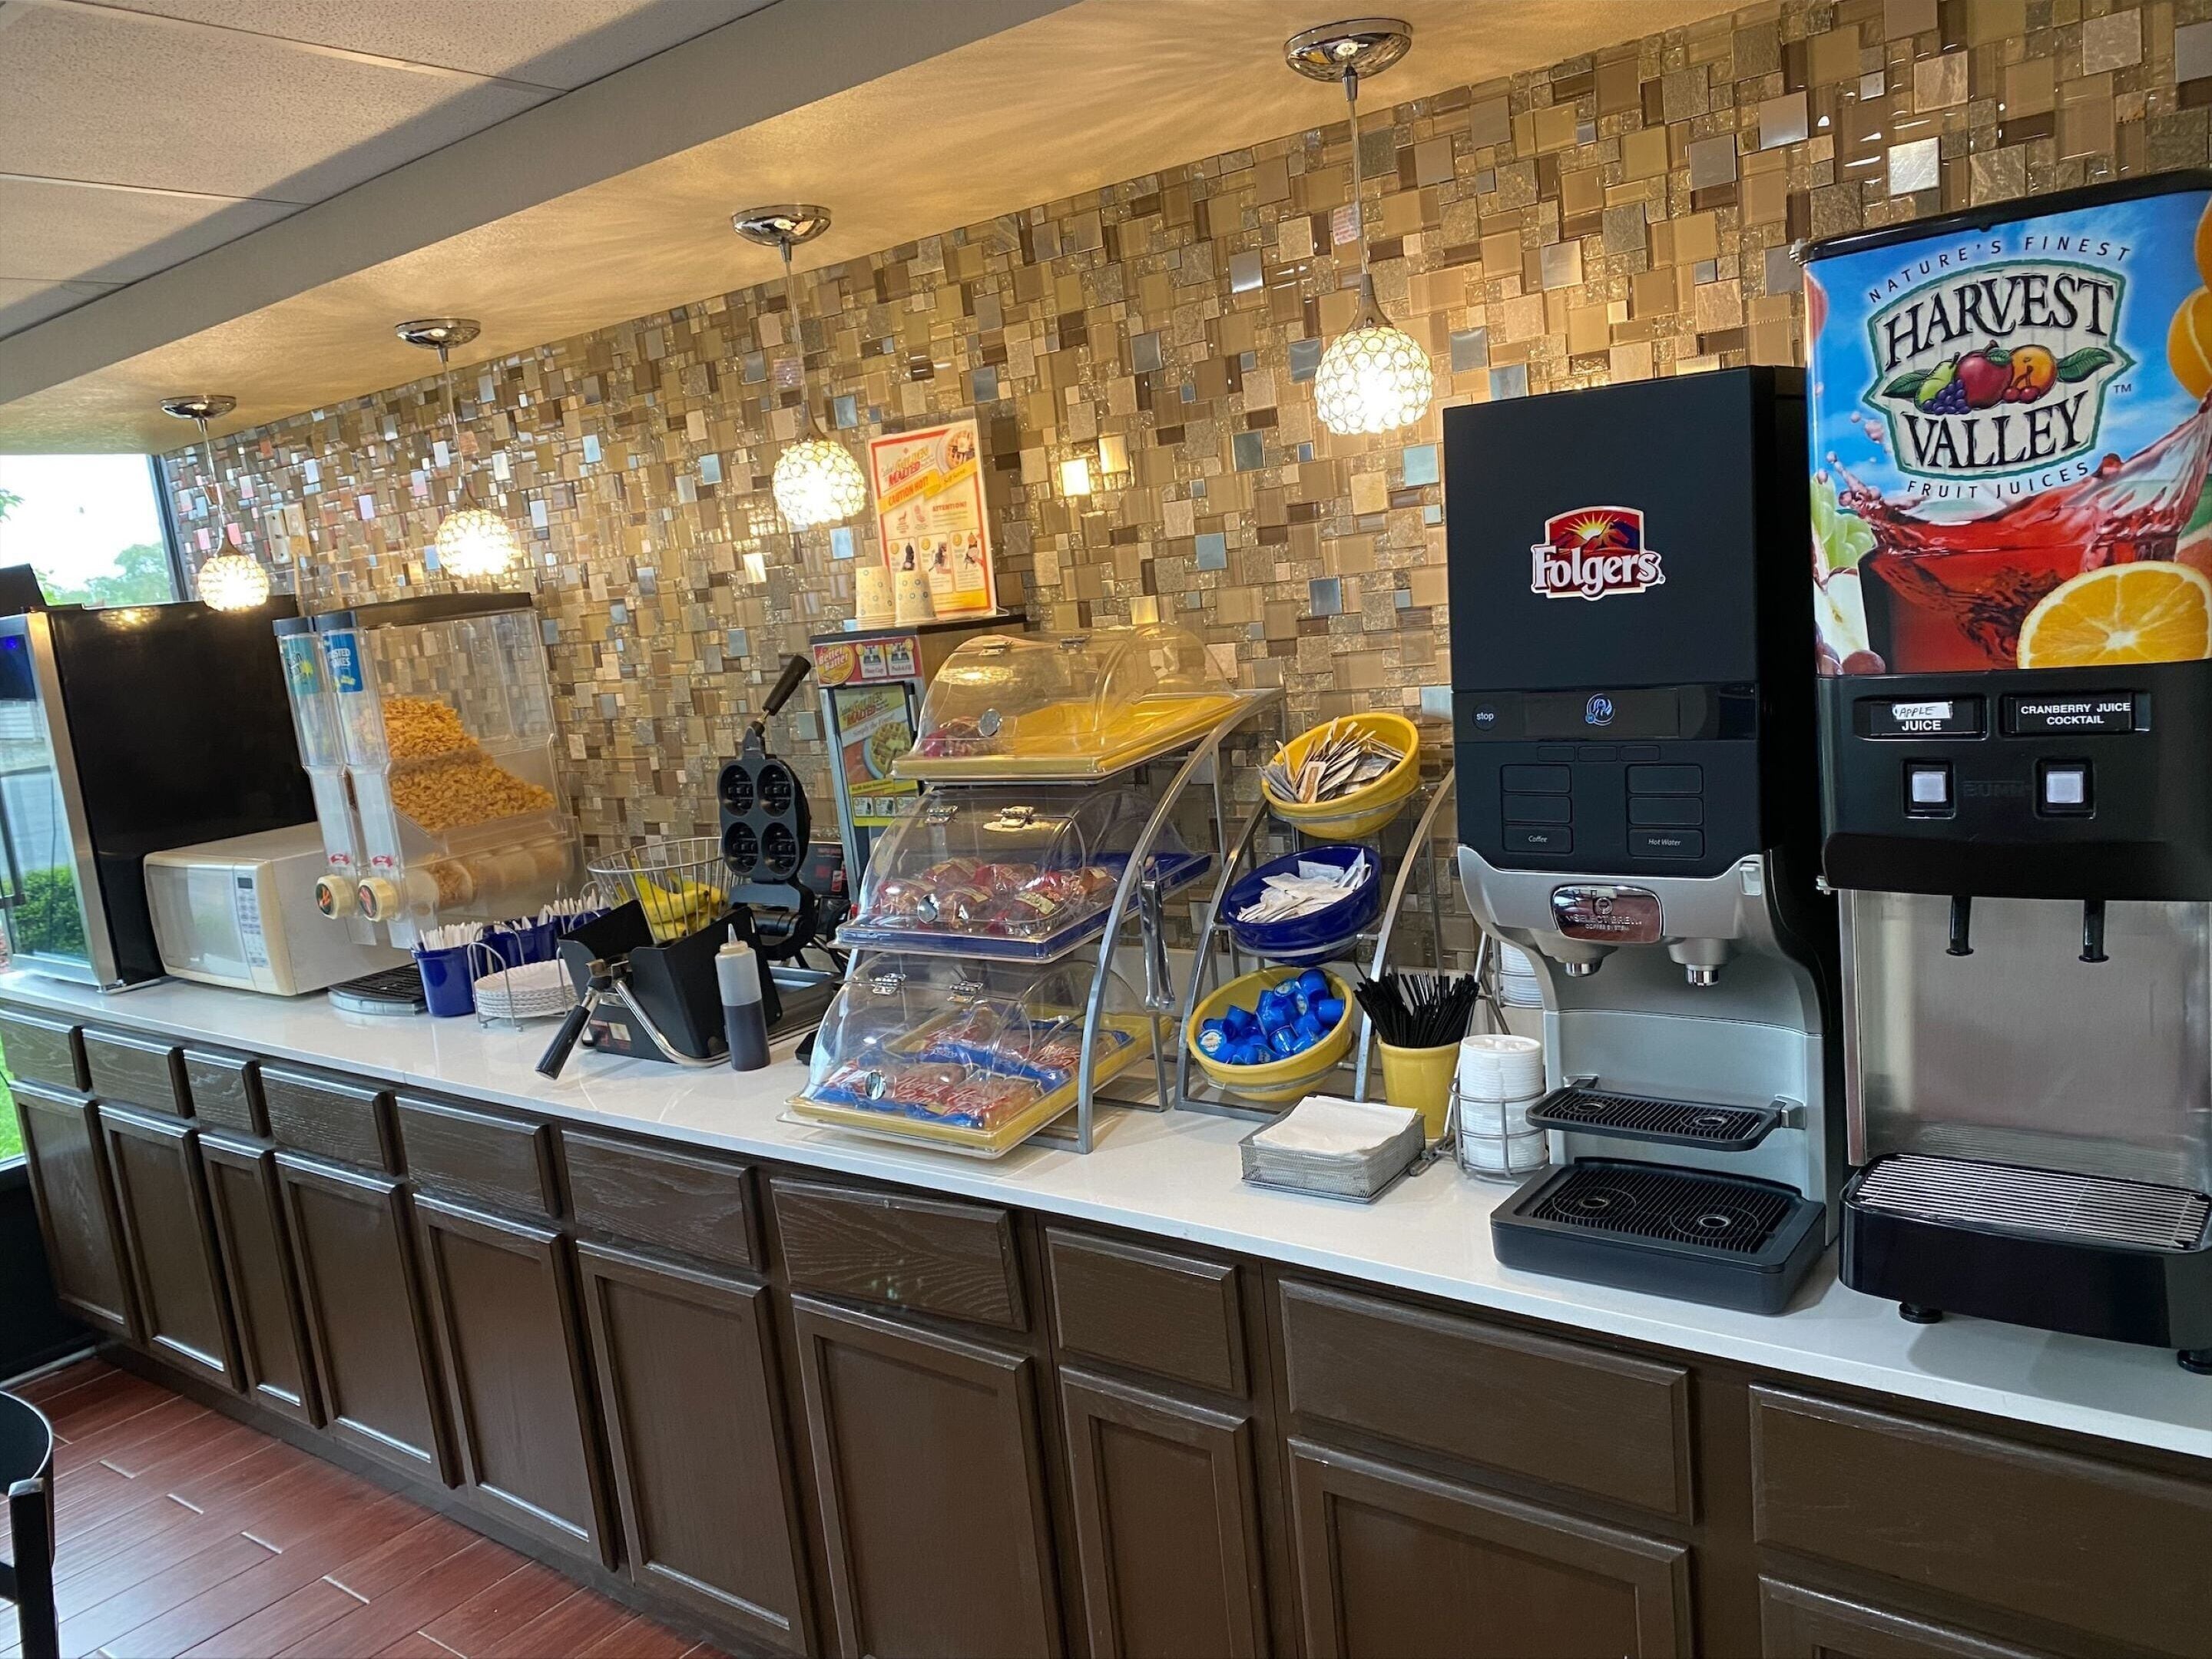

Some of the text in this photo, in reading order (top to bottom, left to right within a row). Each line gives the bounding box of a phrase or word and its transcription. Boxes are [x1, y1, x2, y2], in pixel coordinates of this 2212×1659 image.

[1869, 235, 2132, 303] NATURE'S FINEST
[1884, 273, 2115, 373] HARVEST
[1899, 389, 2090, 469] VALLEY
[1907, 462, 2089, 498] FRUIT JUICES
[888, 484, 914, 507] CAUTION
[932, 501, 967, 512] ATTENTION!
[1532, 545, 1661, 596] Folgers
[818, 646, 844, 665] Better
[824, 653, 849, 671] Batter
[1476, 711, 1495, 722] stop
[1899, 706, 1938, 717] APPLE
[2020, 702, 2131, 714] CRANBERRY JUICE
[1901, 720, 1942, 731] JUICE
[2046, 715, 2105, 726] COCKTAIL
[1528, 835, 1548, 843] Coffee
